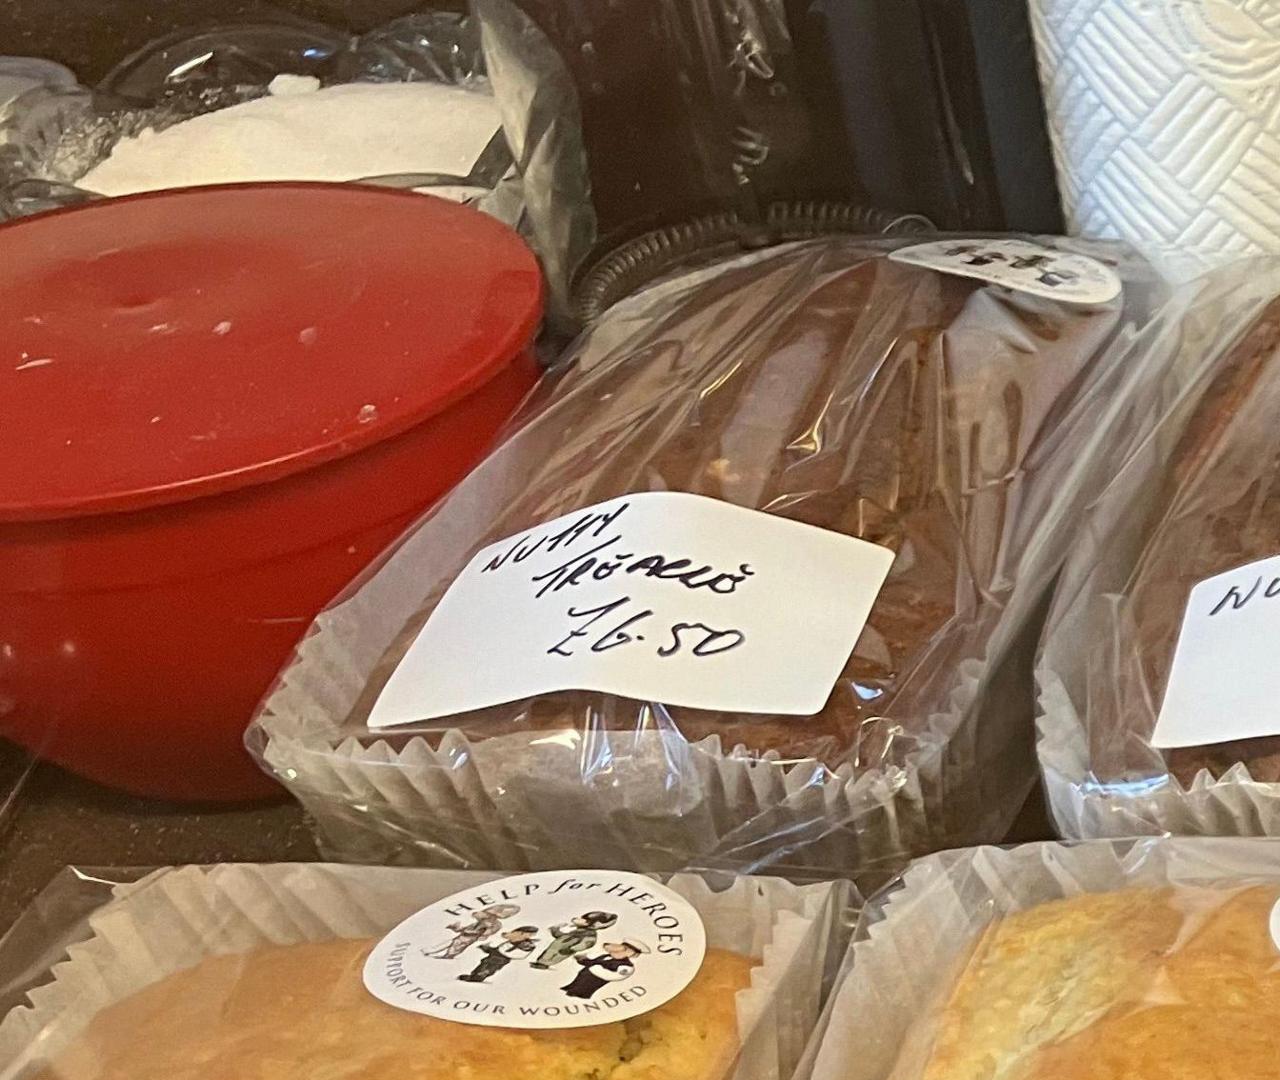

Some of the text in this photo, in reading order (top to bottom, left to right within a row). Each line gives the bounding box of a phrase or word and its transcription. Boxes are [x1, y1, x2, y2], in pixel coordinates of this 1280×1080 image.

[482, 503, 629, 571] NUTTY
[444, 878, 684, 957] HELP for HEROES
[385, 941, 648, 1017] SUPPORT FOR OUR WOUNDED
